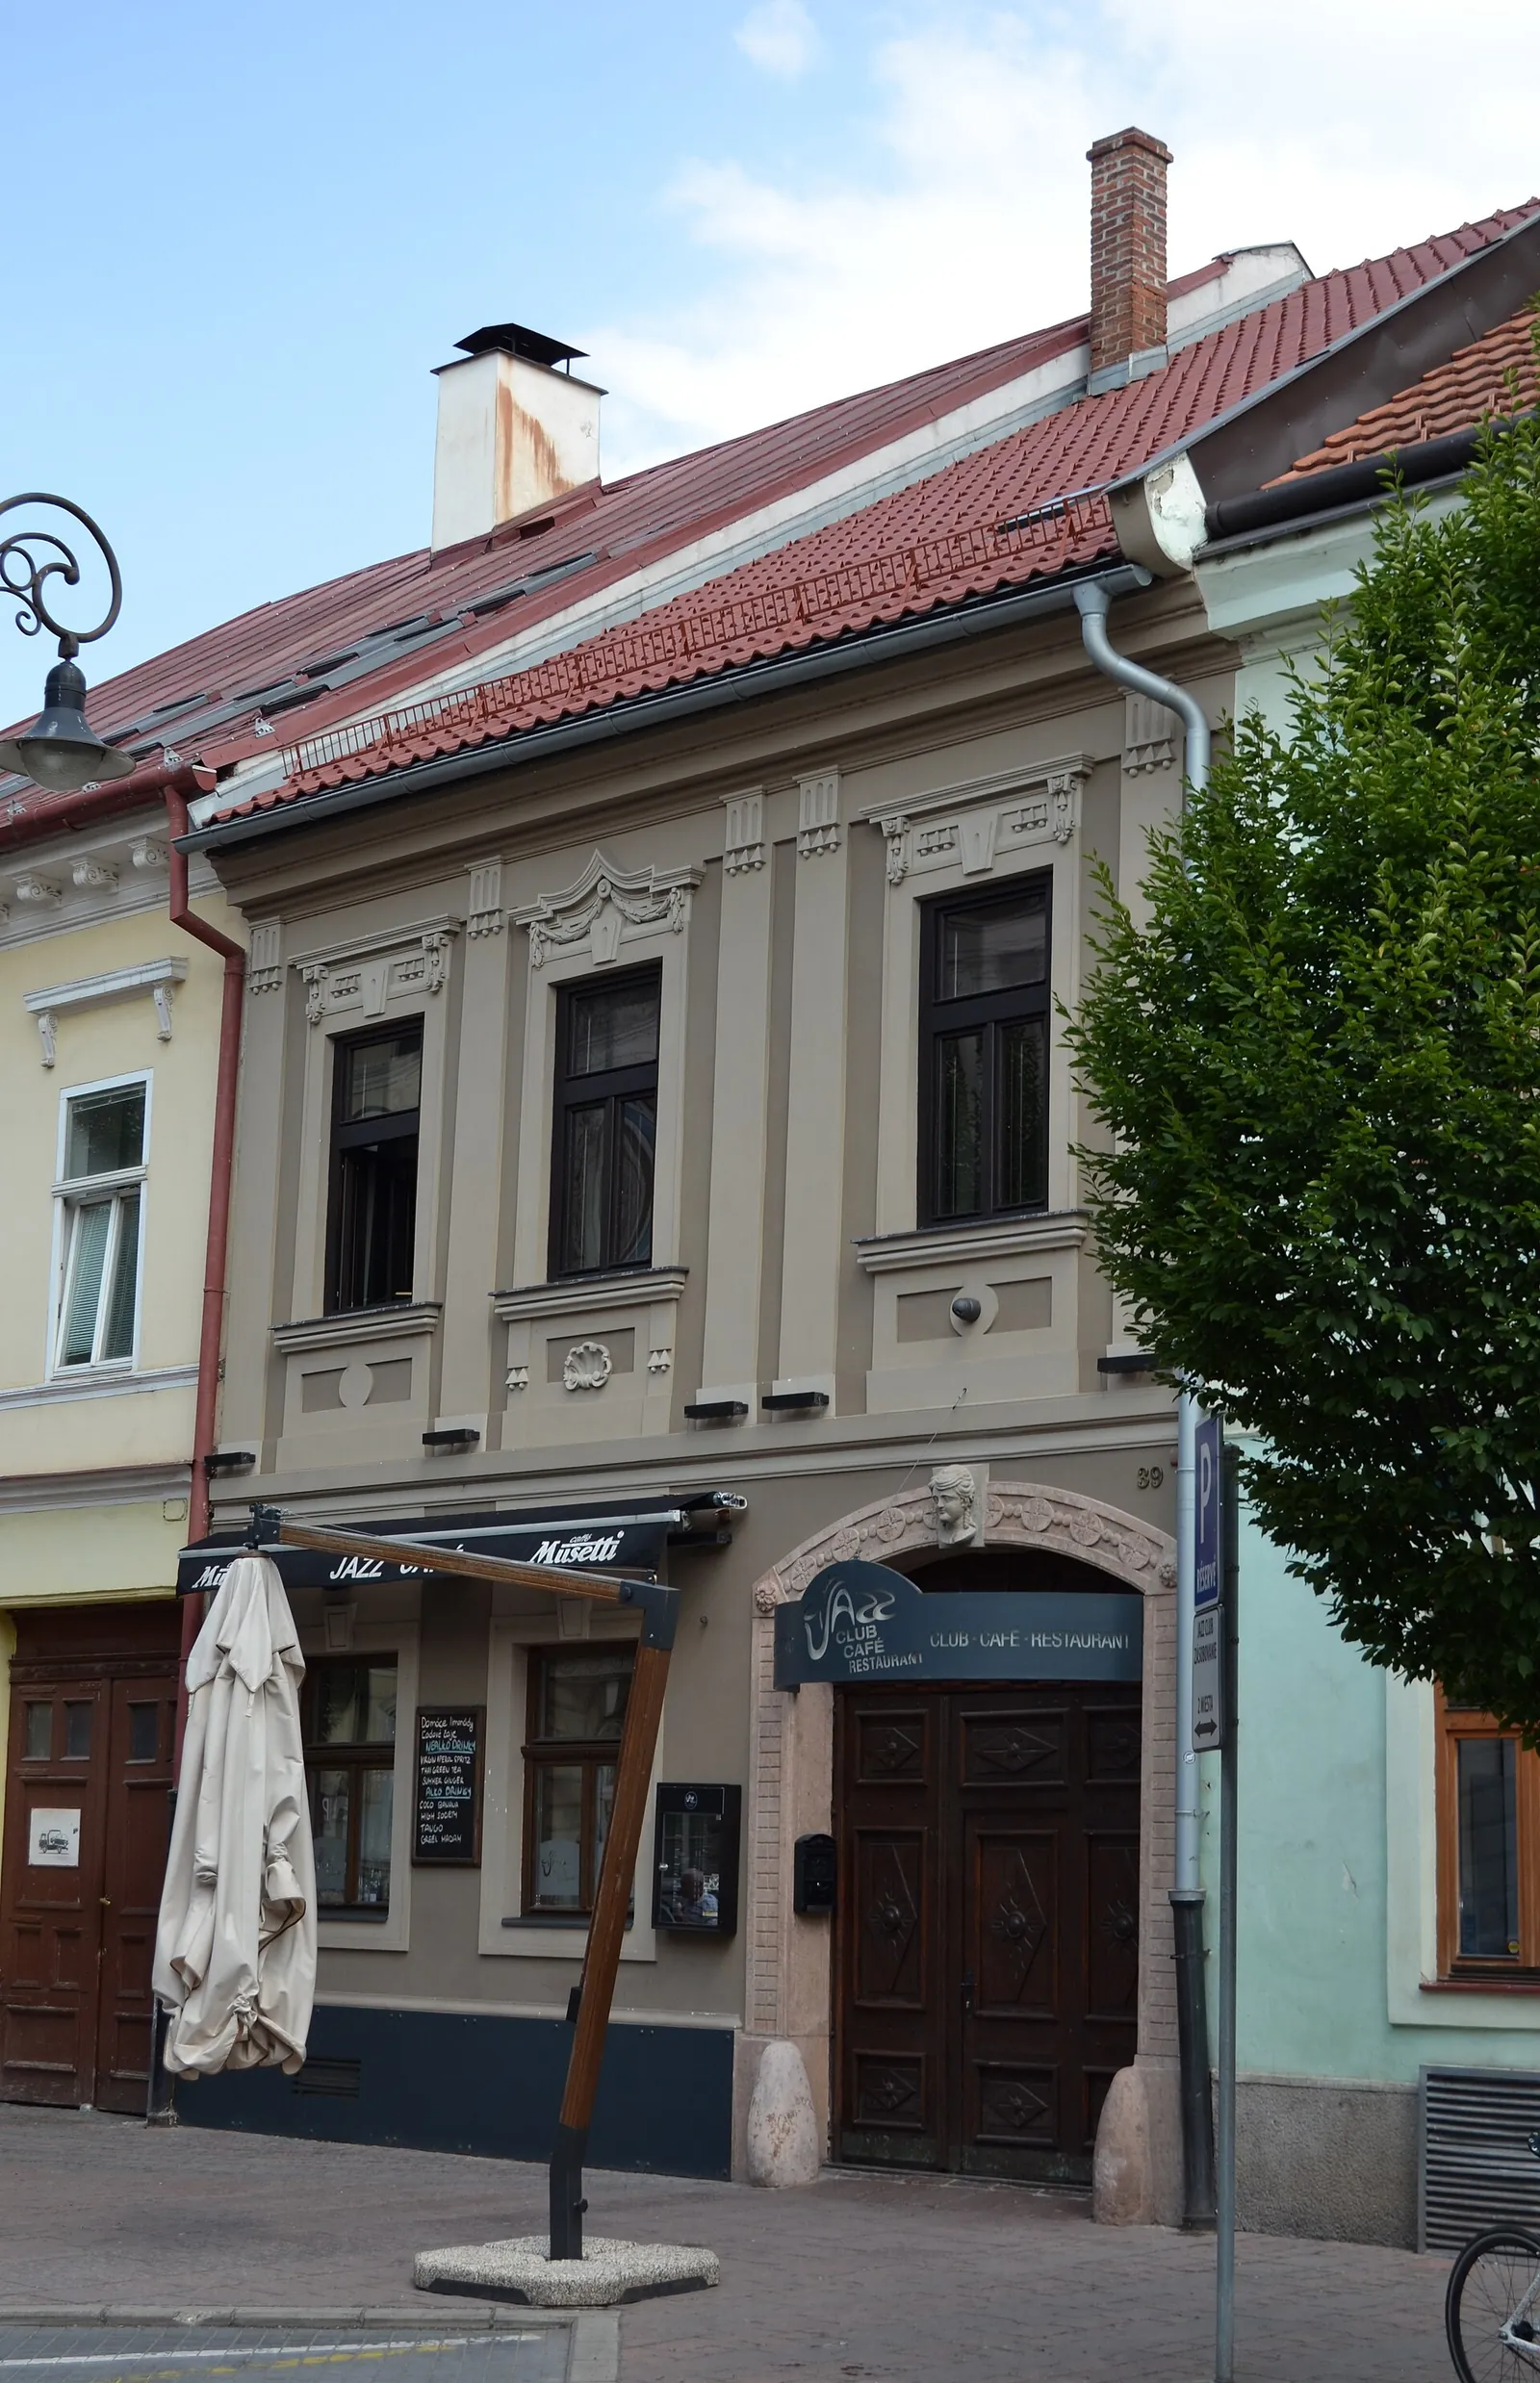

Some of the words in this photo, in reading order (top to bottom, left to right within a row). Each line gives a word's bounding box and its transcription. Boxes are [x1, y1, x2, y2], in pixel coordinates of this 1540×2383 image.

[1138, 1466, 1164, 1489] 39
[1199, 1442, 1212, 1544] P
[526, 1530, 625, 1565] Musetti
[329, 1556, 385, 1579] JAZZ
[835, 1625, 878, 1644] CLUB
[930, 1631, 969, 1648] CLUB
[1031, 1632, 1130, 1649] RESTAURANT
[843, 1637, 885, 1658] CAFÉ
[849, 1653, 923, 1674] RESTAURANT
[420, 1800, 434, 1809] COCO
[420, 1823, 444, 1833] TANGO
